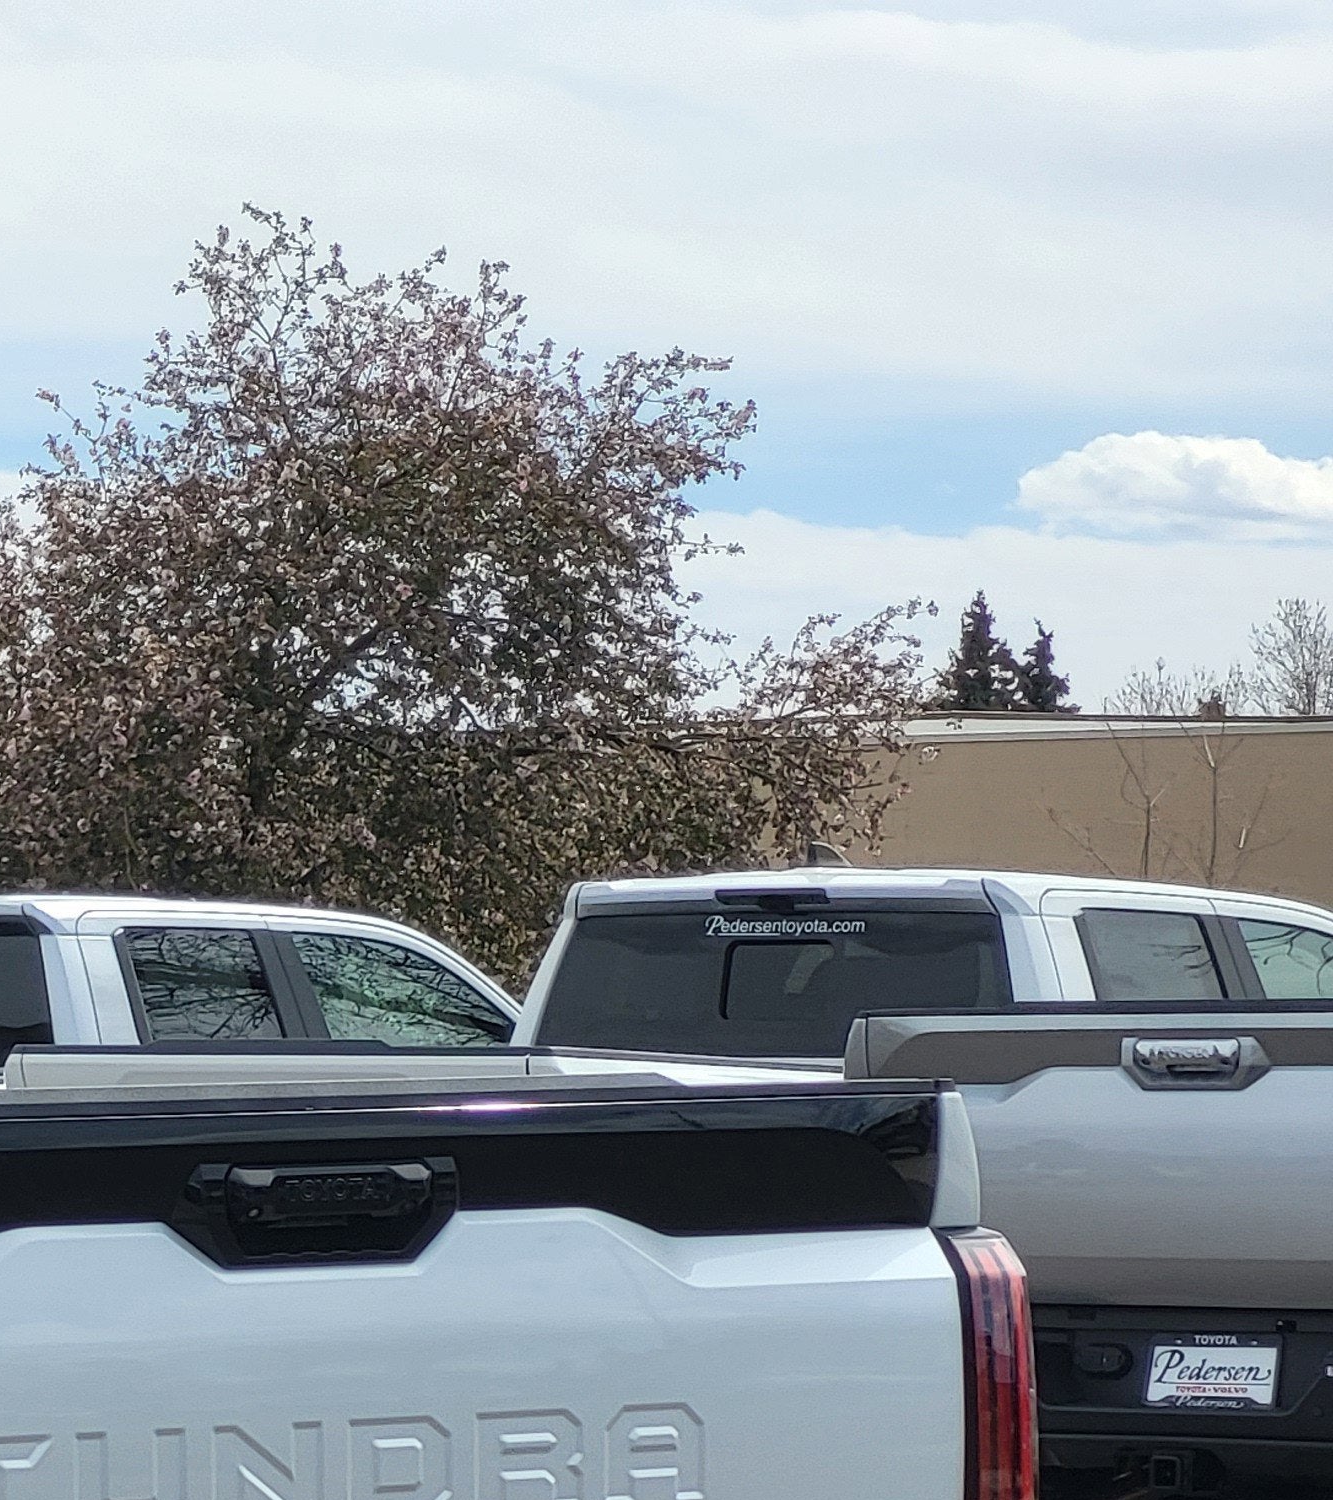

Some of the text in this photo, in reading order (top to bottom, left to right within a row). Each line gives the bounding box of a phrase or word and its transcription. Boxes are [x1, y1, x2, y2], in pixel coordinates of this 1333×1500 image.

[704, 915, 866, 937] Pedersentoyota.com
[285, 1174, 381, 1202] TOYOTA
[1193, 1334, 1238, 1345] TOYOTA
[1154, 1349, 1272, 1384] Pedersen
[1176, 1385, 1248, 1394] TOYOTA VOLVO
